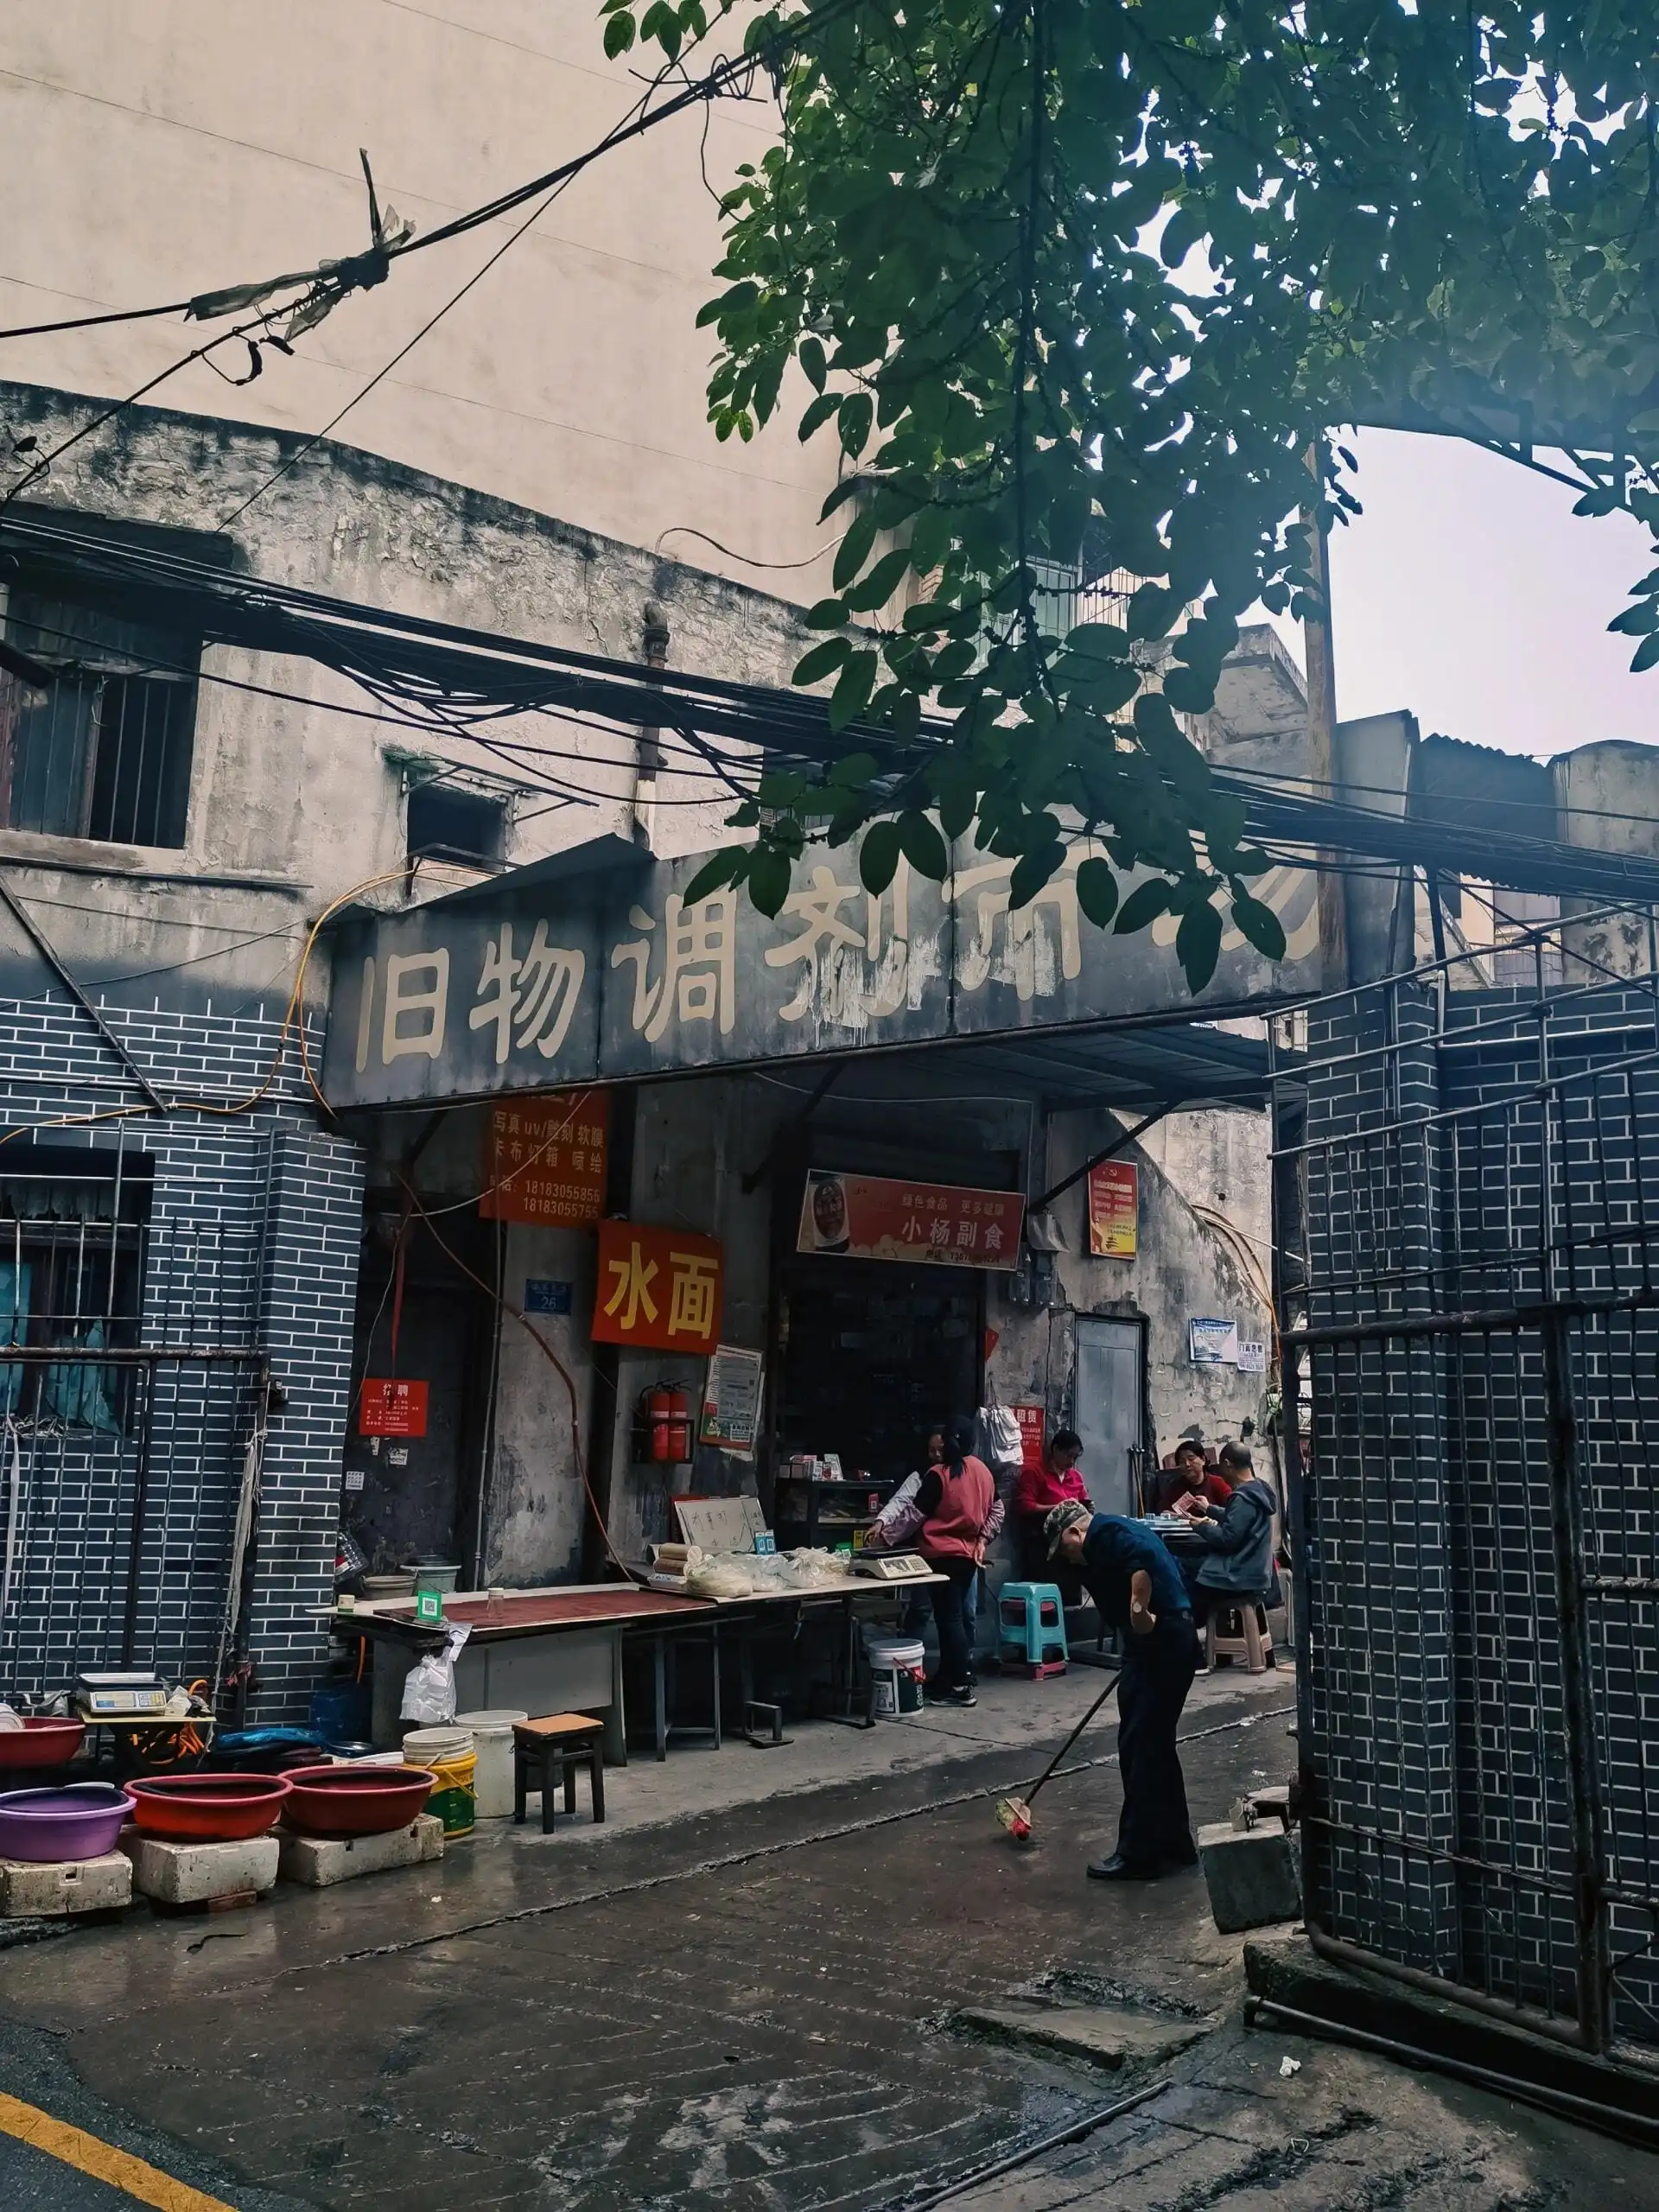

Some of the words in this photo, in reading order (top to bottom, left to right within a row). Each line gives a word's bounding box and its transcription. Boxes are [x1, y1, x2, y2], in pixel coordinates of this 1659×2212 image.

[494, 1110, 520, 1135] 写真
[578, 1125, 604, 1148] 软膜
[901, 1193, 949, 1211] 绿色食品
[901, 1215, 1005, 1250] 小杨副食
[603, 1241, 719, 1339] 水面
[541, 1296, 557, 1311] 26
[1012, 1408, 1038, 1424] 租赁
